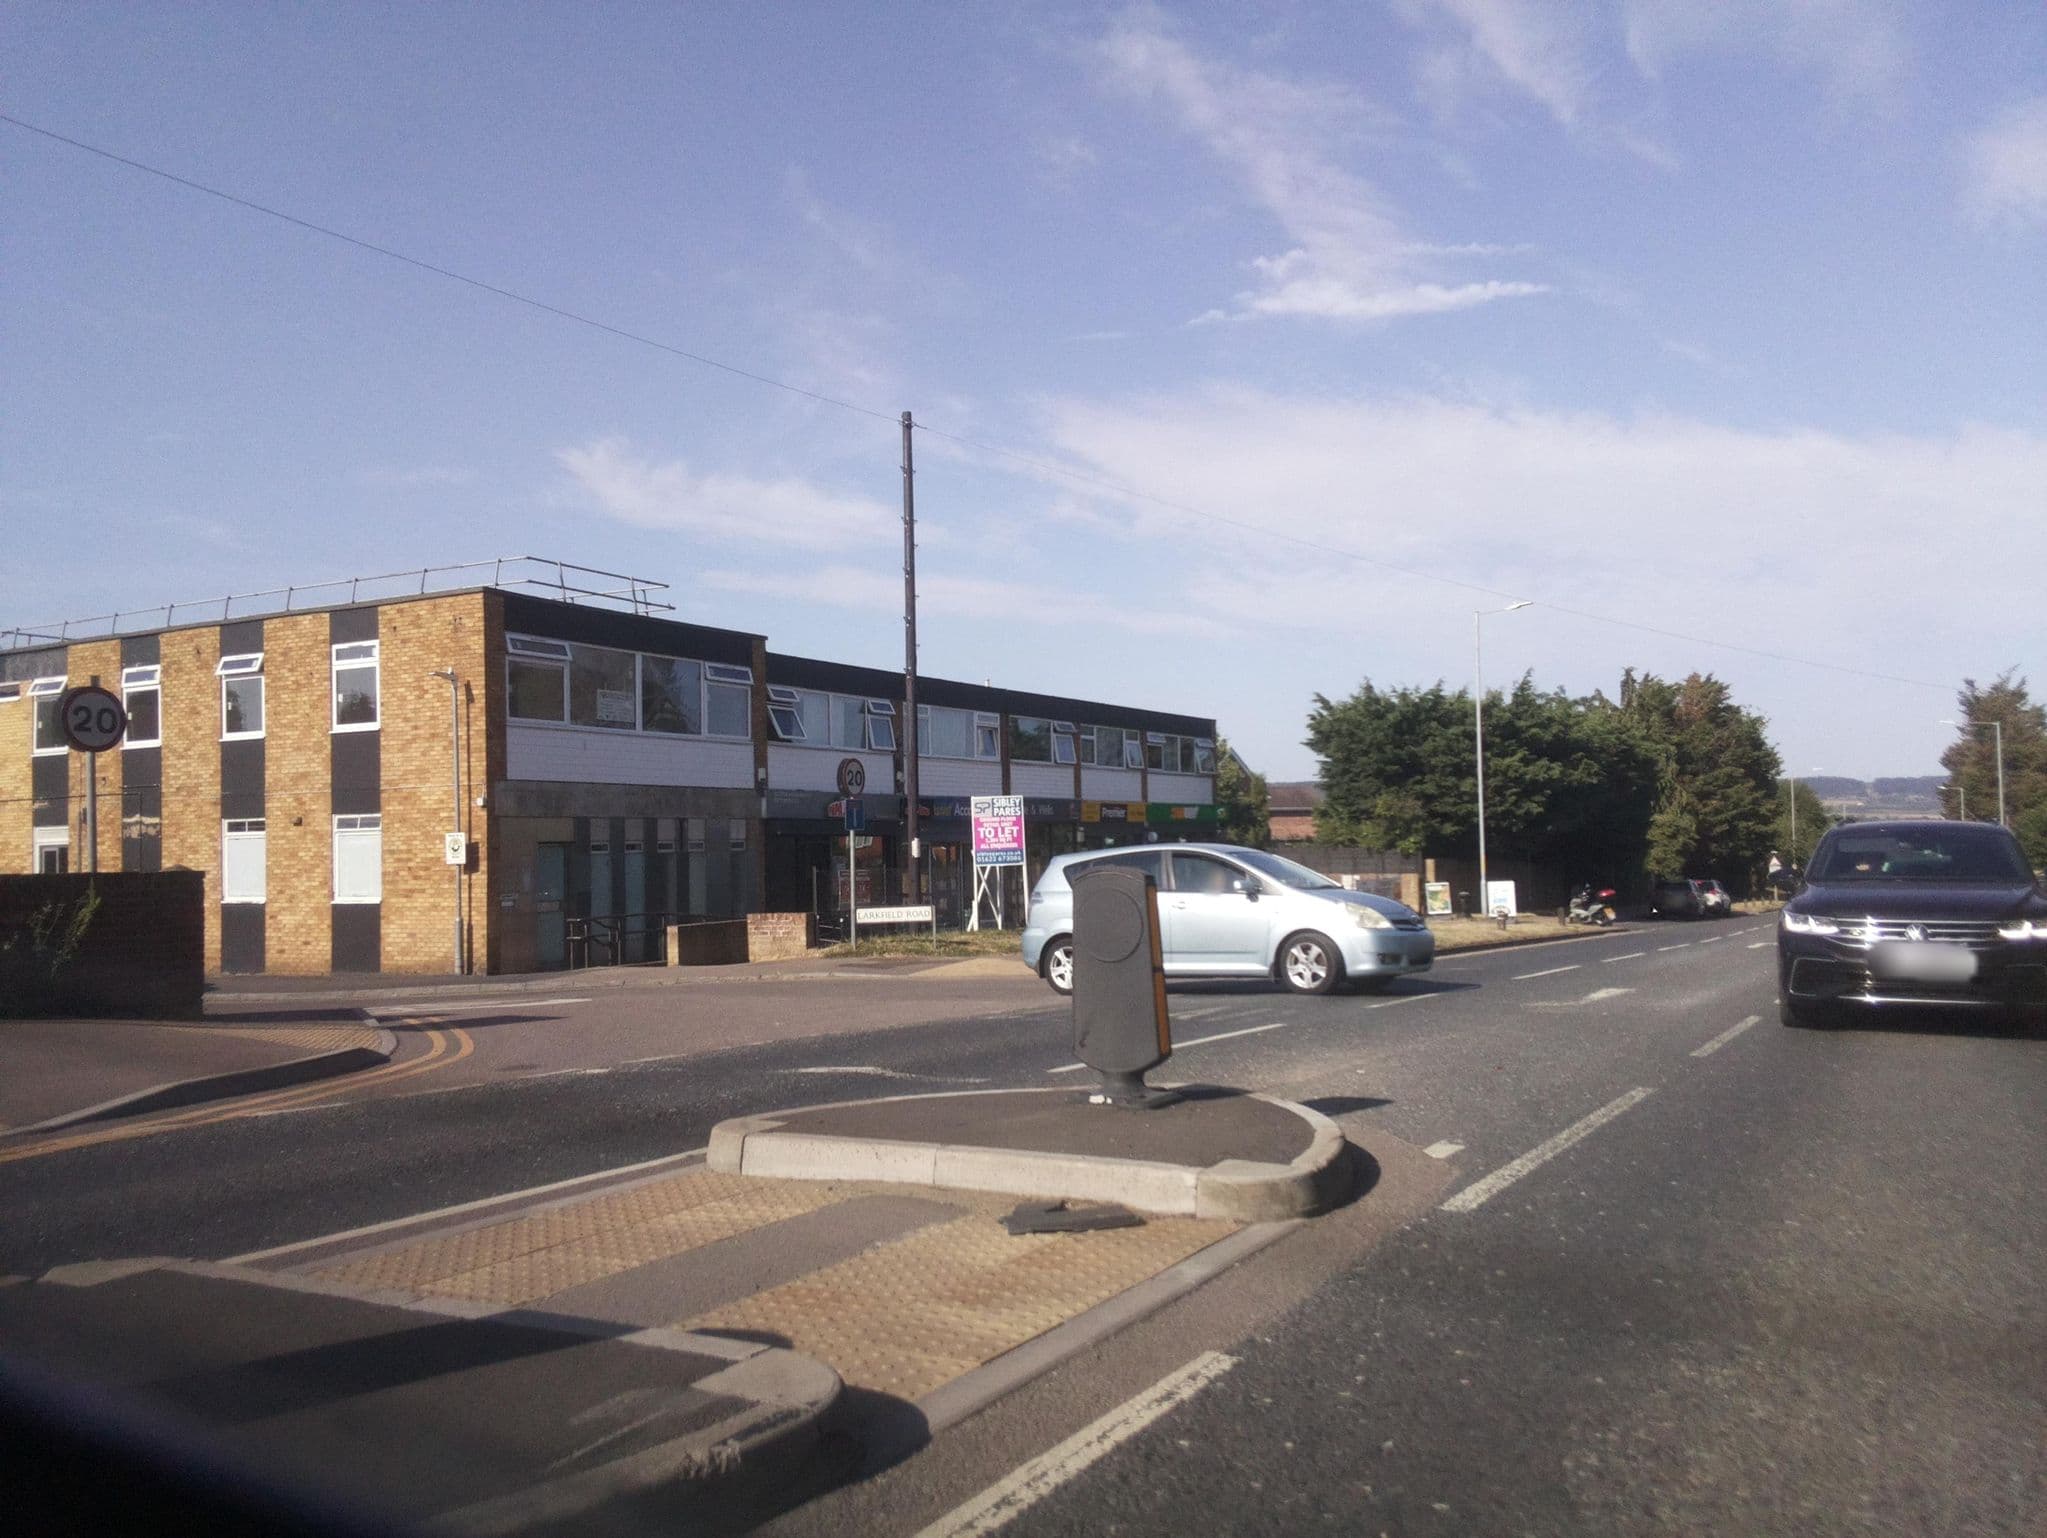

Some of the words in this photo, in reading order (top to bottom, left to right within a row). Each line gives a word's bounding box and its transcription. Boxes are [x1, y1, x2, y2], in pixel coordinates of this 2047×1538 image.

[72, 705, 118, 734] 20
[848, 770, 863, 786] 20
[993, 798, 1021, 808] SIBLEY
[993, 807, 1021, 817] PARES
[977, 827, 994, 839] TO
[997, 826, 1019, 838] LET
[858, 910, 904, 921] LARKFIELD
[906, 910, 931, 919] ROAD
